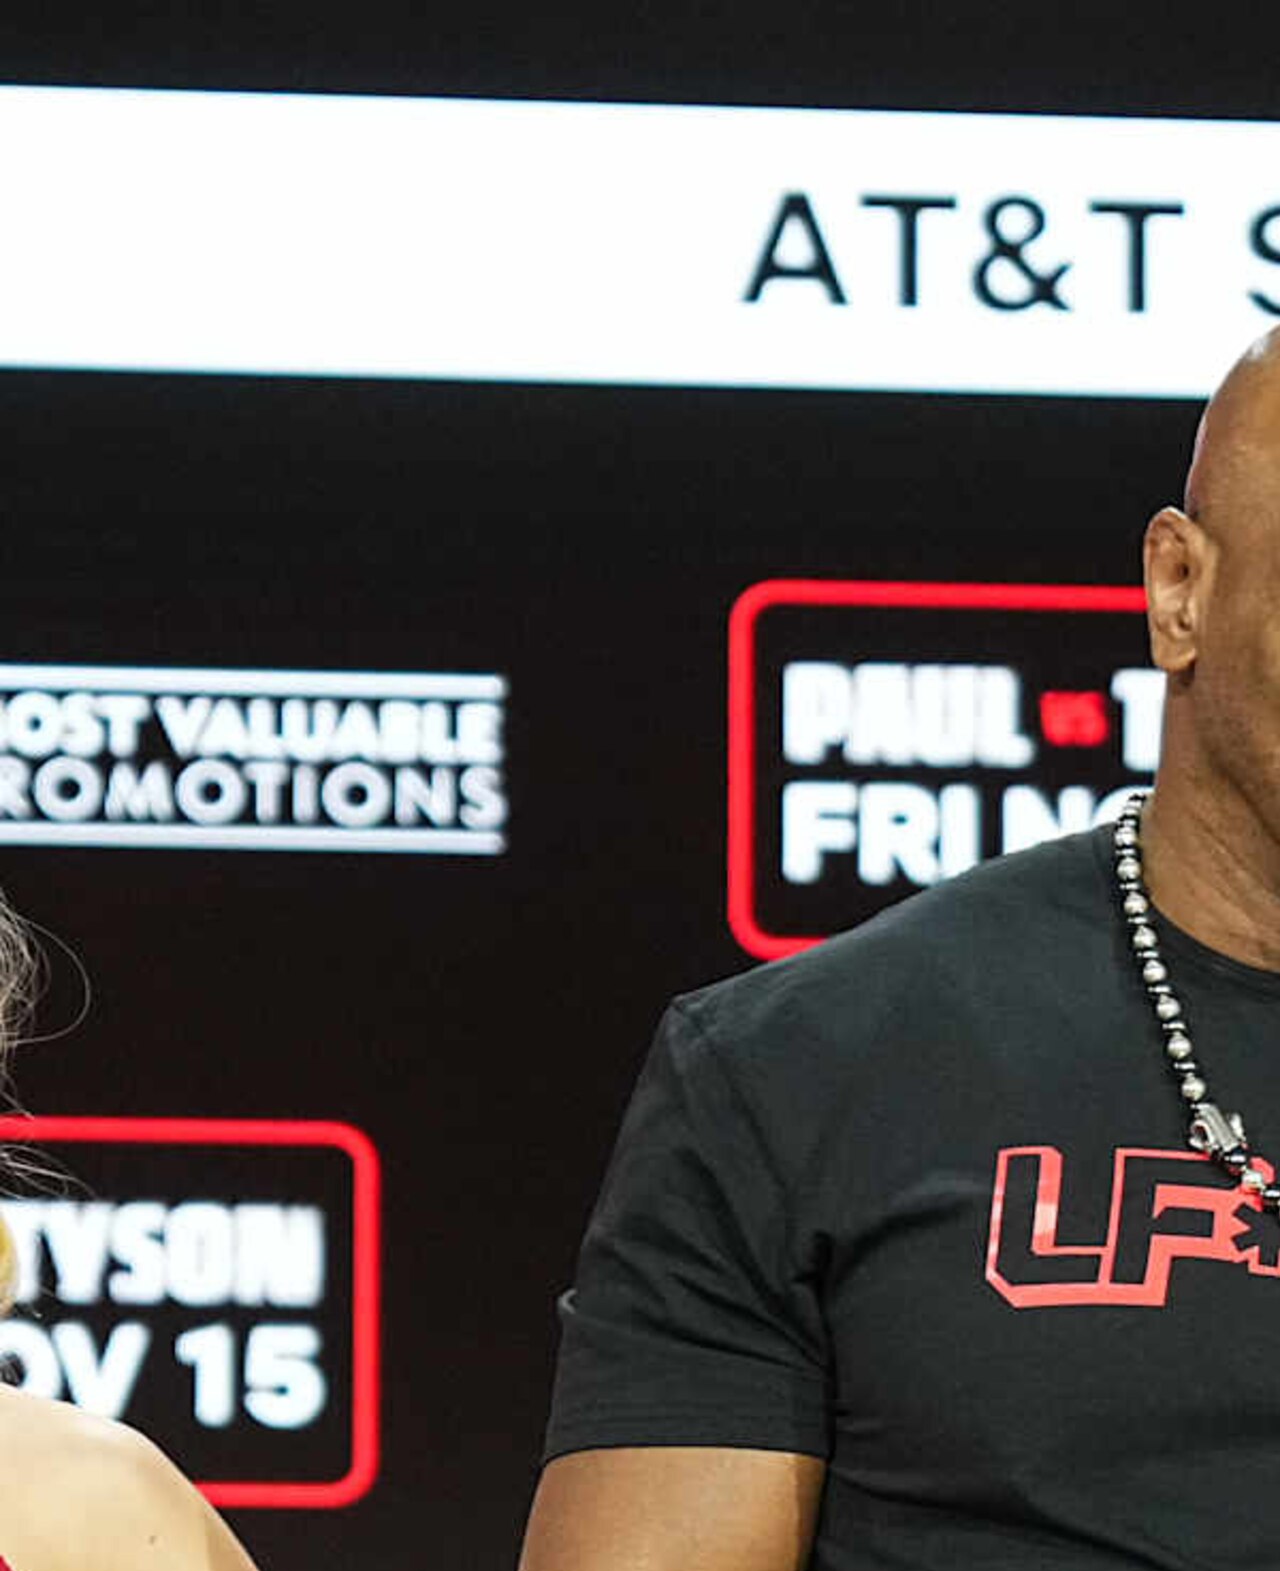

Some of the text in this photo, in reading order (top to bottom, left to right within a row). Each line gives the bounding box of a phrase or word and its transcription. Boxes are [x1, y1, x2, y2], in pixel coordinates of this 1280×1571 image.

[741, 190, 1184, 313] AT&T
[0, 690, 504, 764] OST VALUABLE
[781, 780, 981, 886] FRI
[174, 1322, 327, 1430] 15
